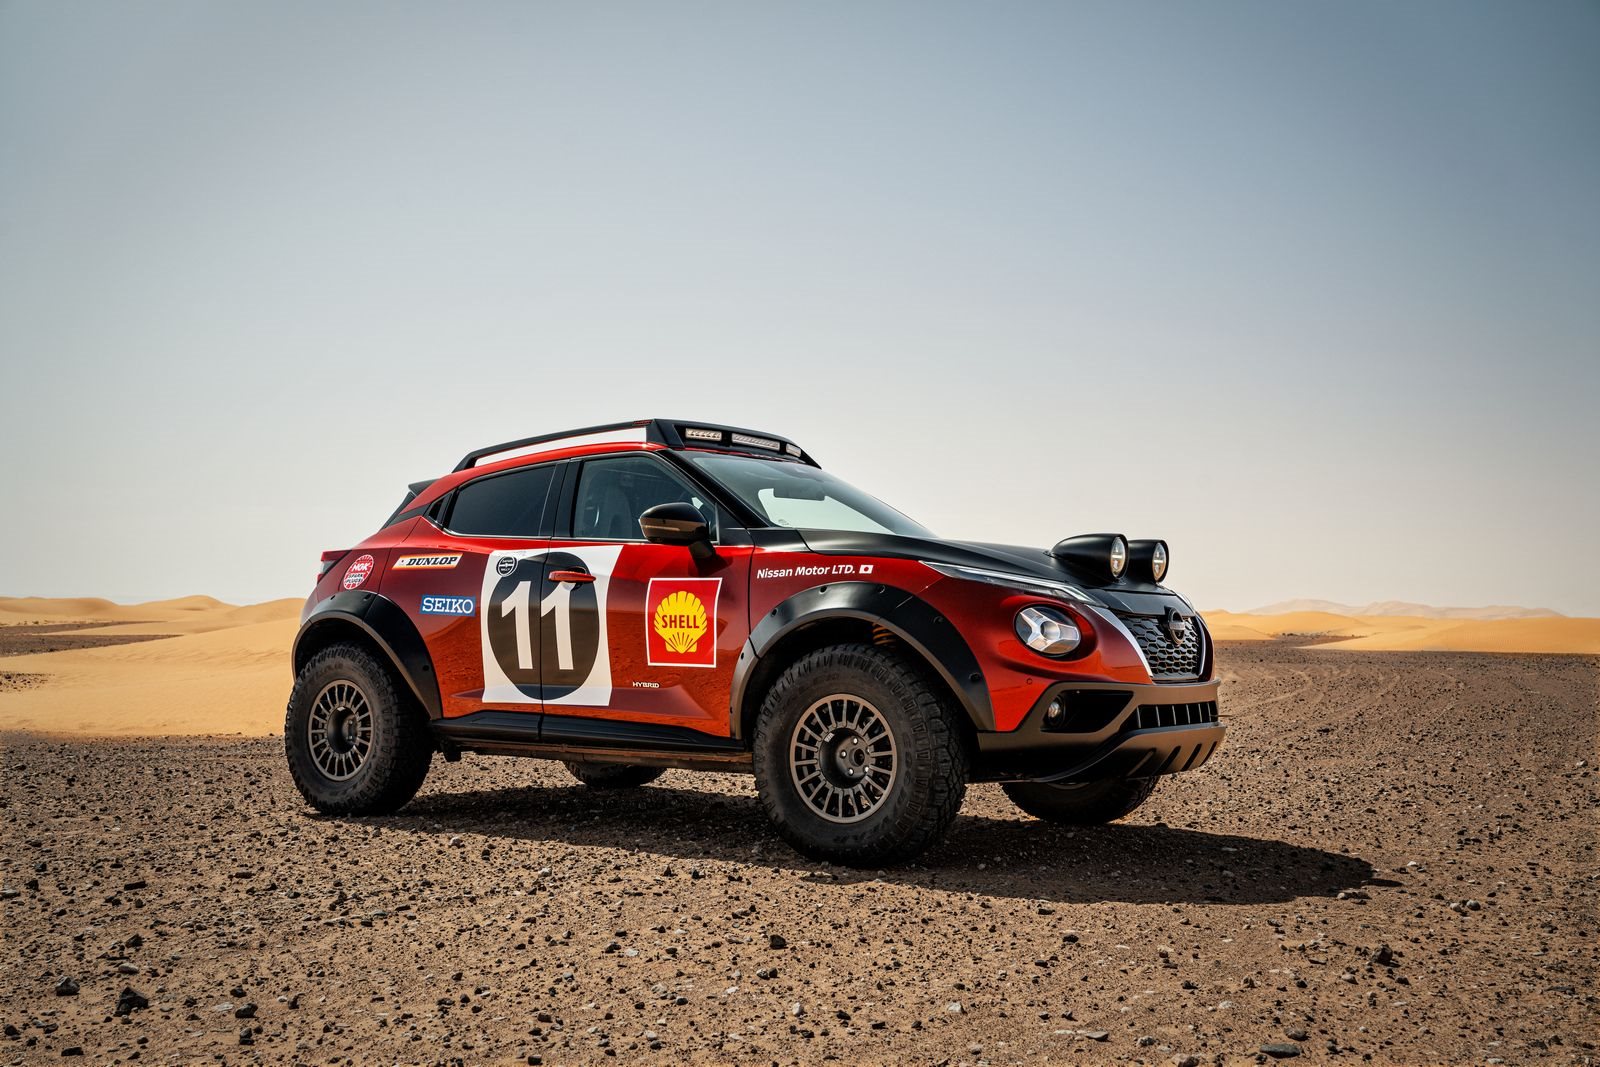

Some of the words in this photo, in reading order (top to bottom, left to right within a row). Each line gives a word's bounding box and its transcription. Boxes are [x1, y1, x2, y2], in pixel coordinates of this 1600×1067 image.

[351, 562, 371, 571] NGK
[406, 557, 458, 566] DUNLOP
[756, 568, 793, 579] Nissan
[794, 566, 831, 576] Motor
[831, 565, 856, 575] LTD.
[422, 597, 474, 614] SEIKO
[501, 580, 576, 670] 11
[661, 614, 700, 629] SHELL
[632, 681, 660, 689] HYBRID
